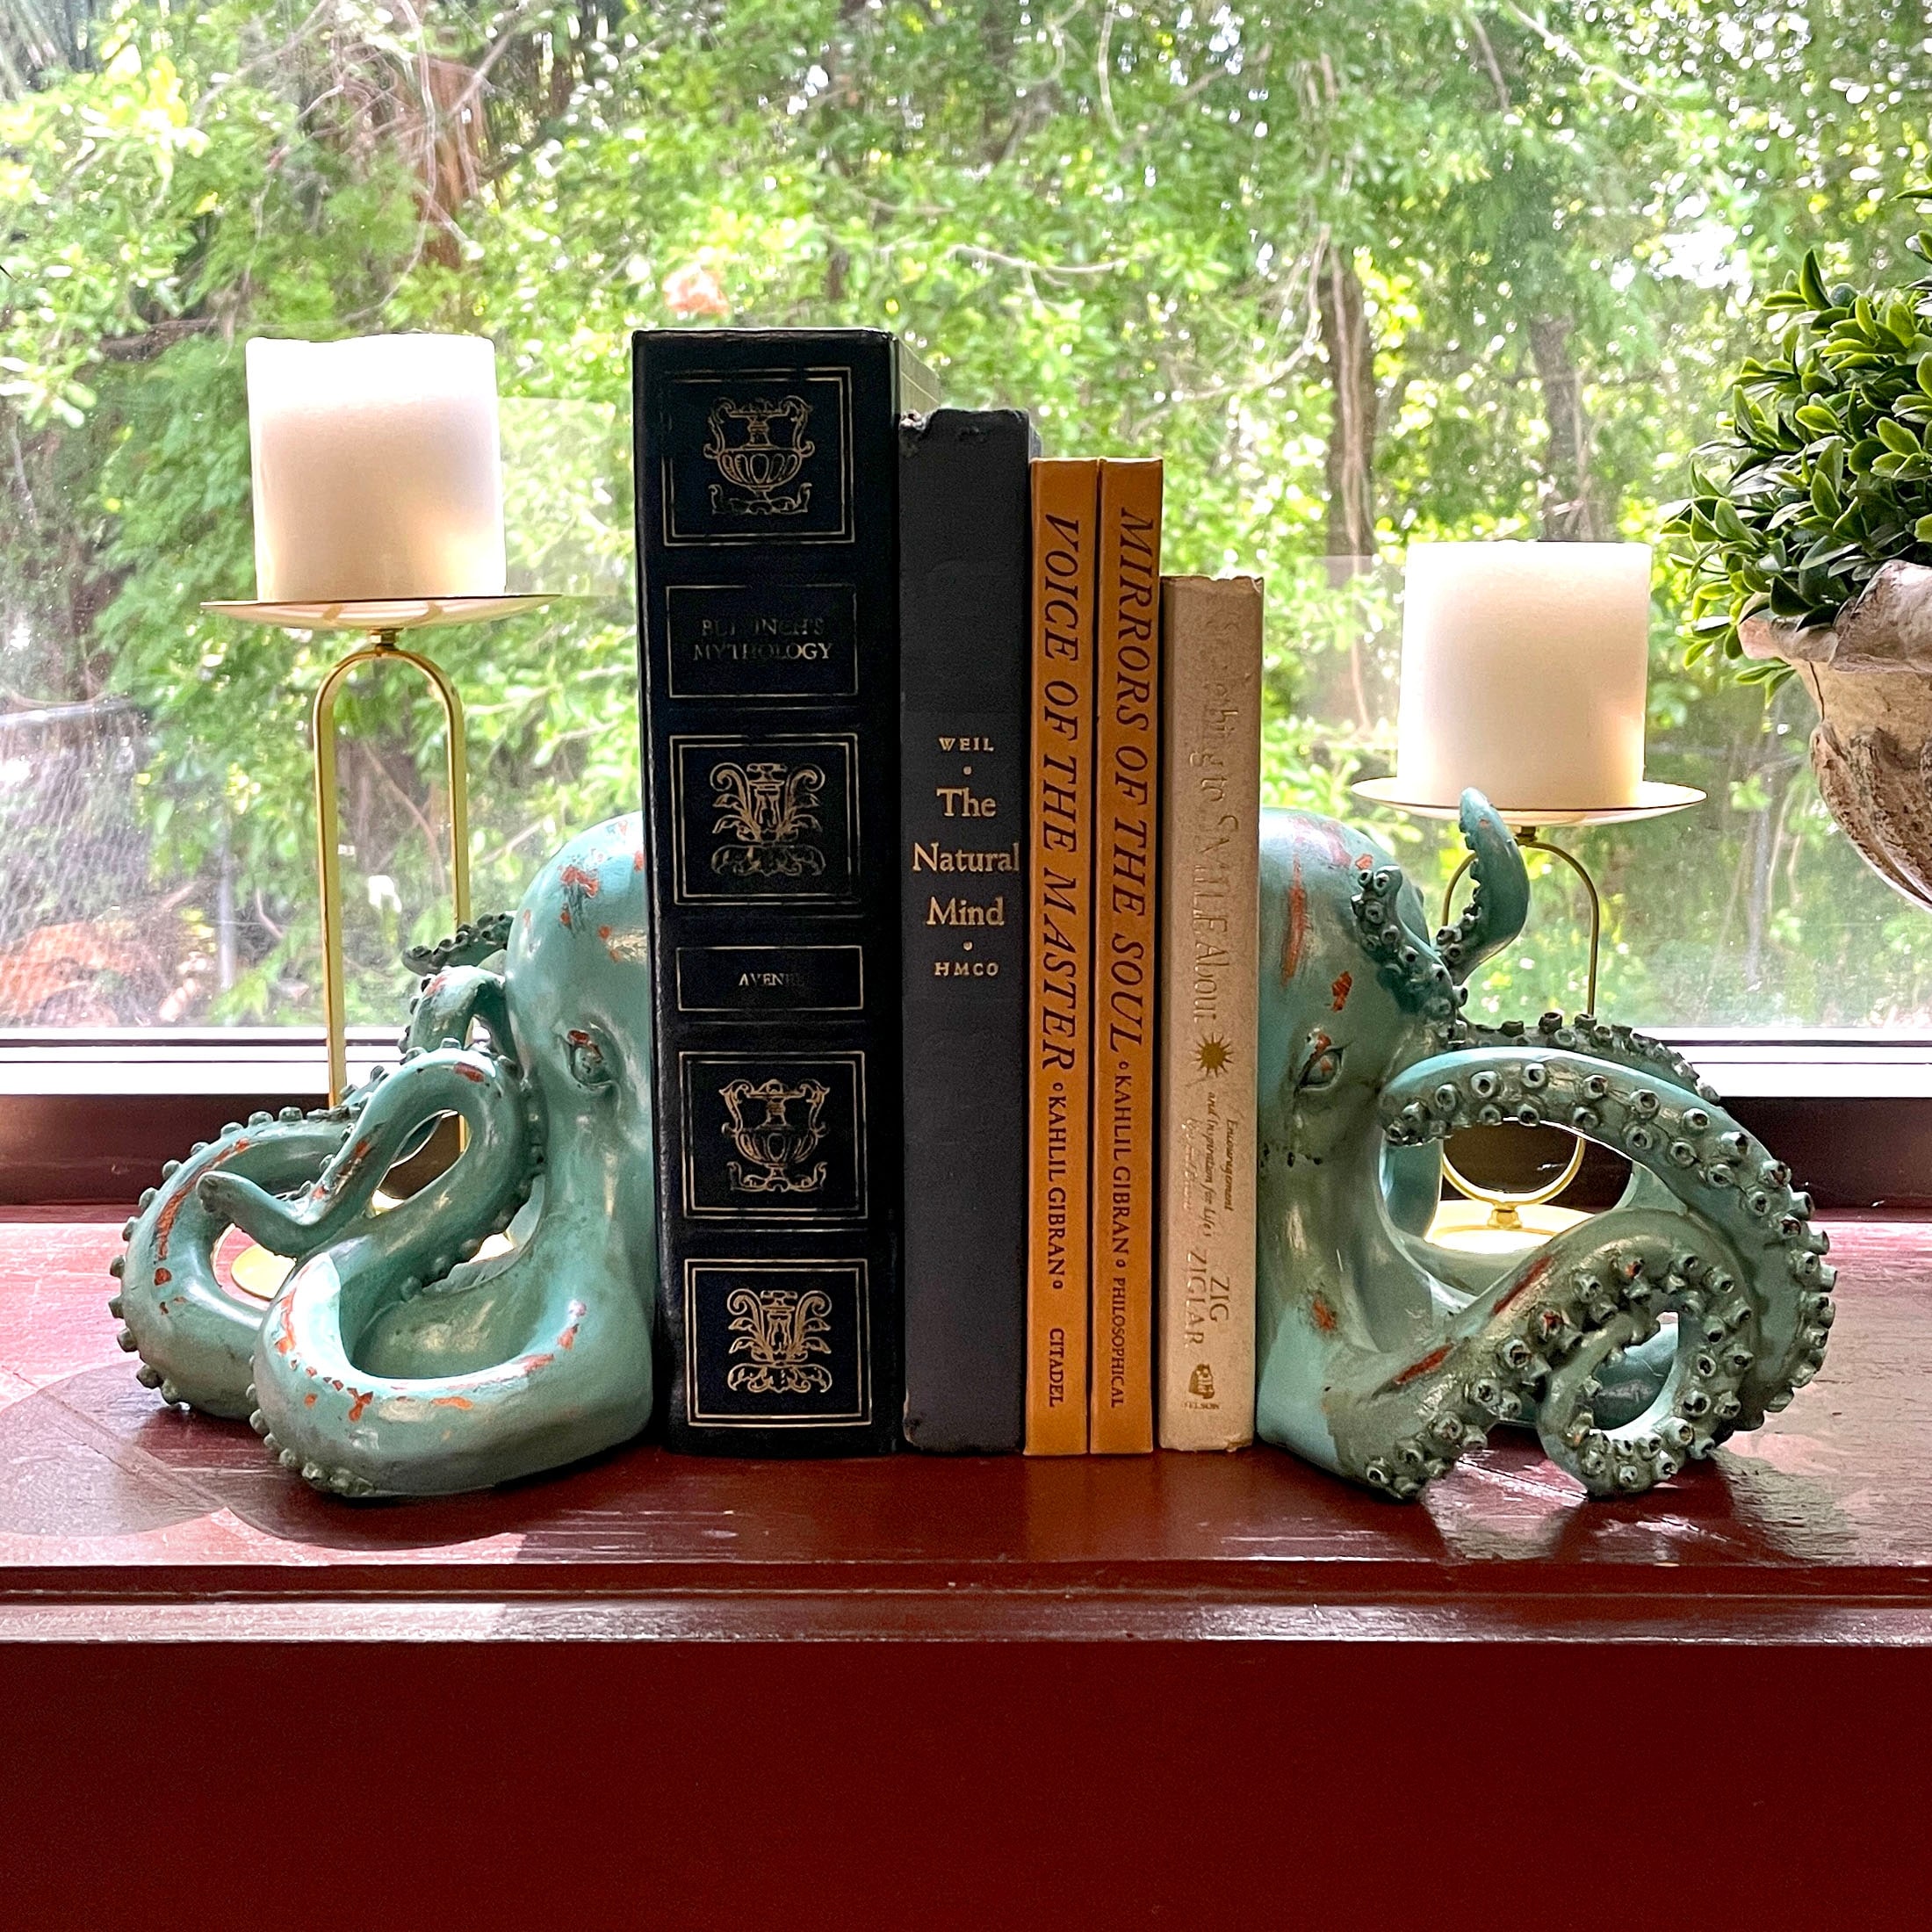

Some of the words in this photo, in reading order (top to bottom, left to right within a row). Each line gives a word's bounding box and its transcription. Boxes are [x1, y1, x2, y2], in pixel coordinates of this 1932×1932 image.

[700, 617, 825, 637] BULINCH'S
[1044, 513, 1080, 662] VOICE
[1115, 507, 1155, 732] MIRRORS
[692, 642, 833, 661] MYTHOLOGY
[938, 736, 995, 752] WEIL
[1043, 680, 1079, 741] OF
[936, 786, 998, 818] The
[1042, 753, 1078, 853] THE
[1114, 745, 1149, 806] OF
[912, 840, 1020, 872] Natural
[1112, 817, 1149, 917] THE
[926, 895, 1005, 926] Mind
[934, 961, 999, 977] HMCO
[1042, 867, 1078, 1071] MASTER
[1109, 933, 1146, 1054] SOUL
[1048, 1095, 1067, 1182] KAHLIL
[1113, 1074, 1133, 1161] KAHLIL
[1207, 1091, 1220, 1120] and
[1200, 1183, 1216, 1205] for
[1219, 1118, 1239, 1212] Encouragement
[1048, 1186, 1067, 1276] GIBRAN
[1112, 1165, 1132, 1256] GIBRAN
[1185, 1249, 1208, 1347] ZIGLAR
[1208, 1276, 1231, 1323] ZIG
[1049, 1327, 1064, 1409] CITADEL
[1110, 1276, 1126, 1409] PHILOSOPHICAL
